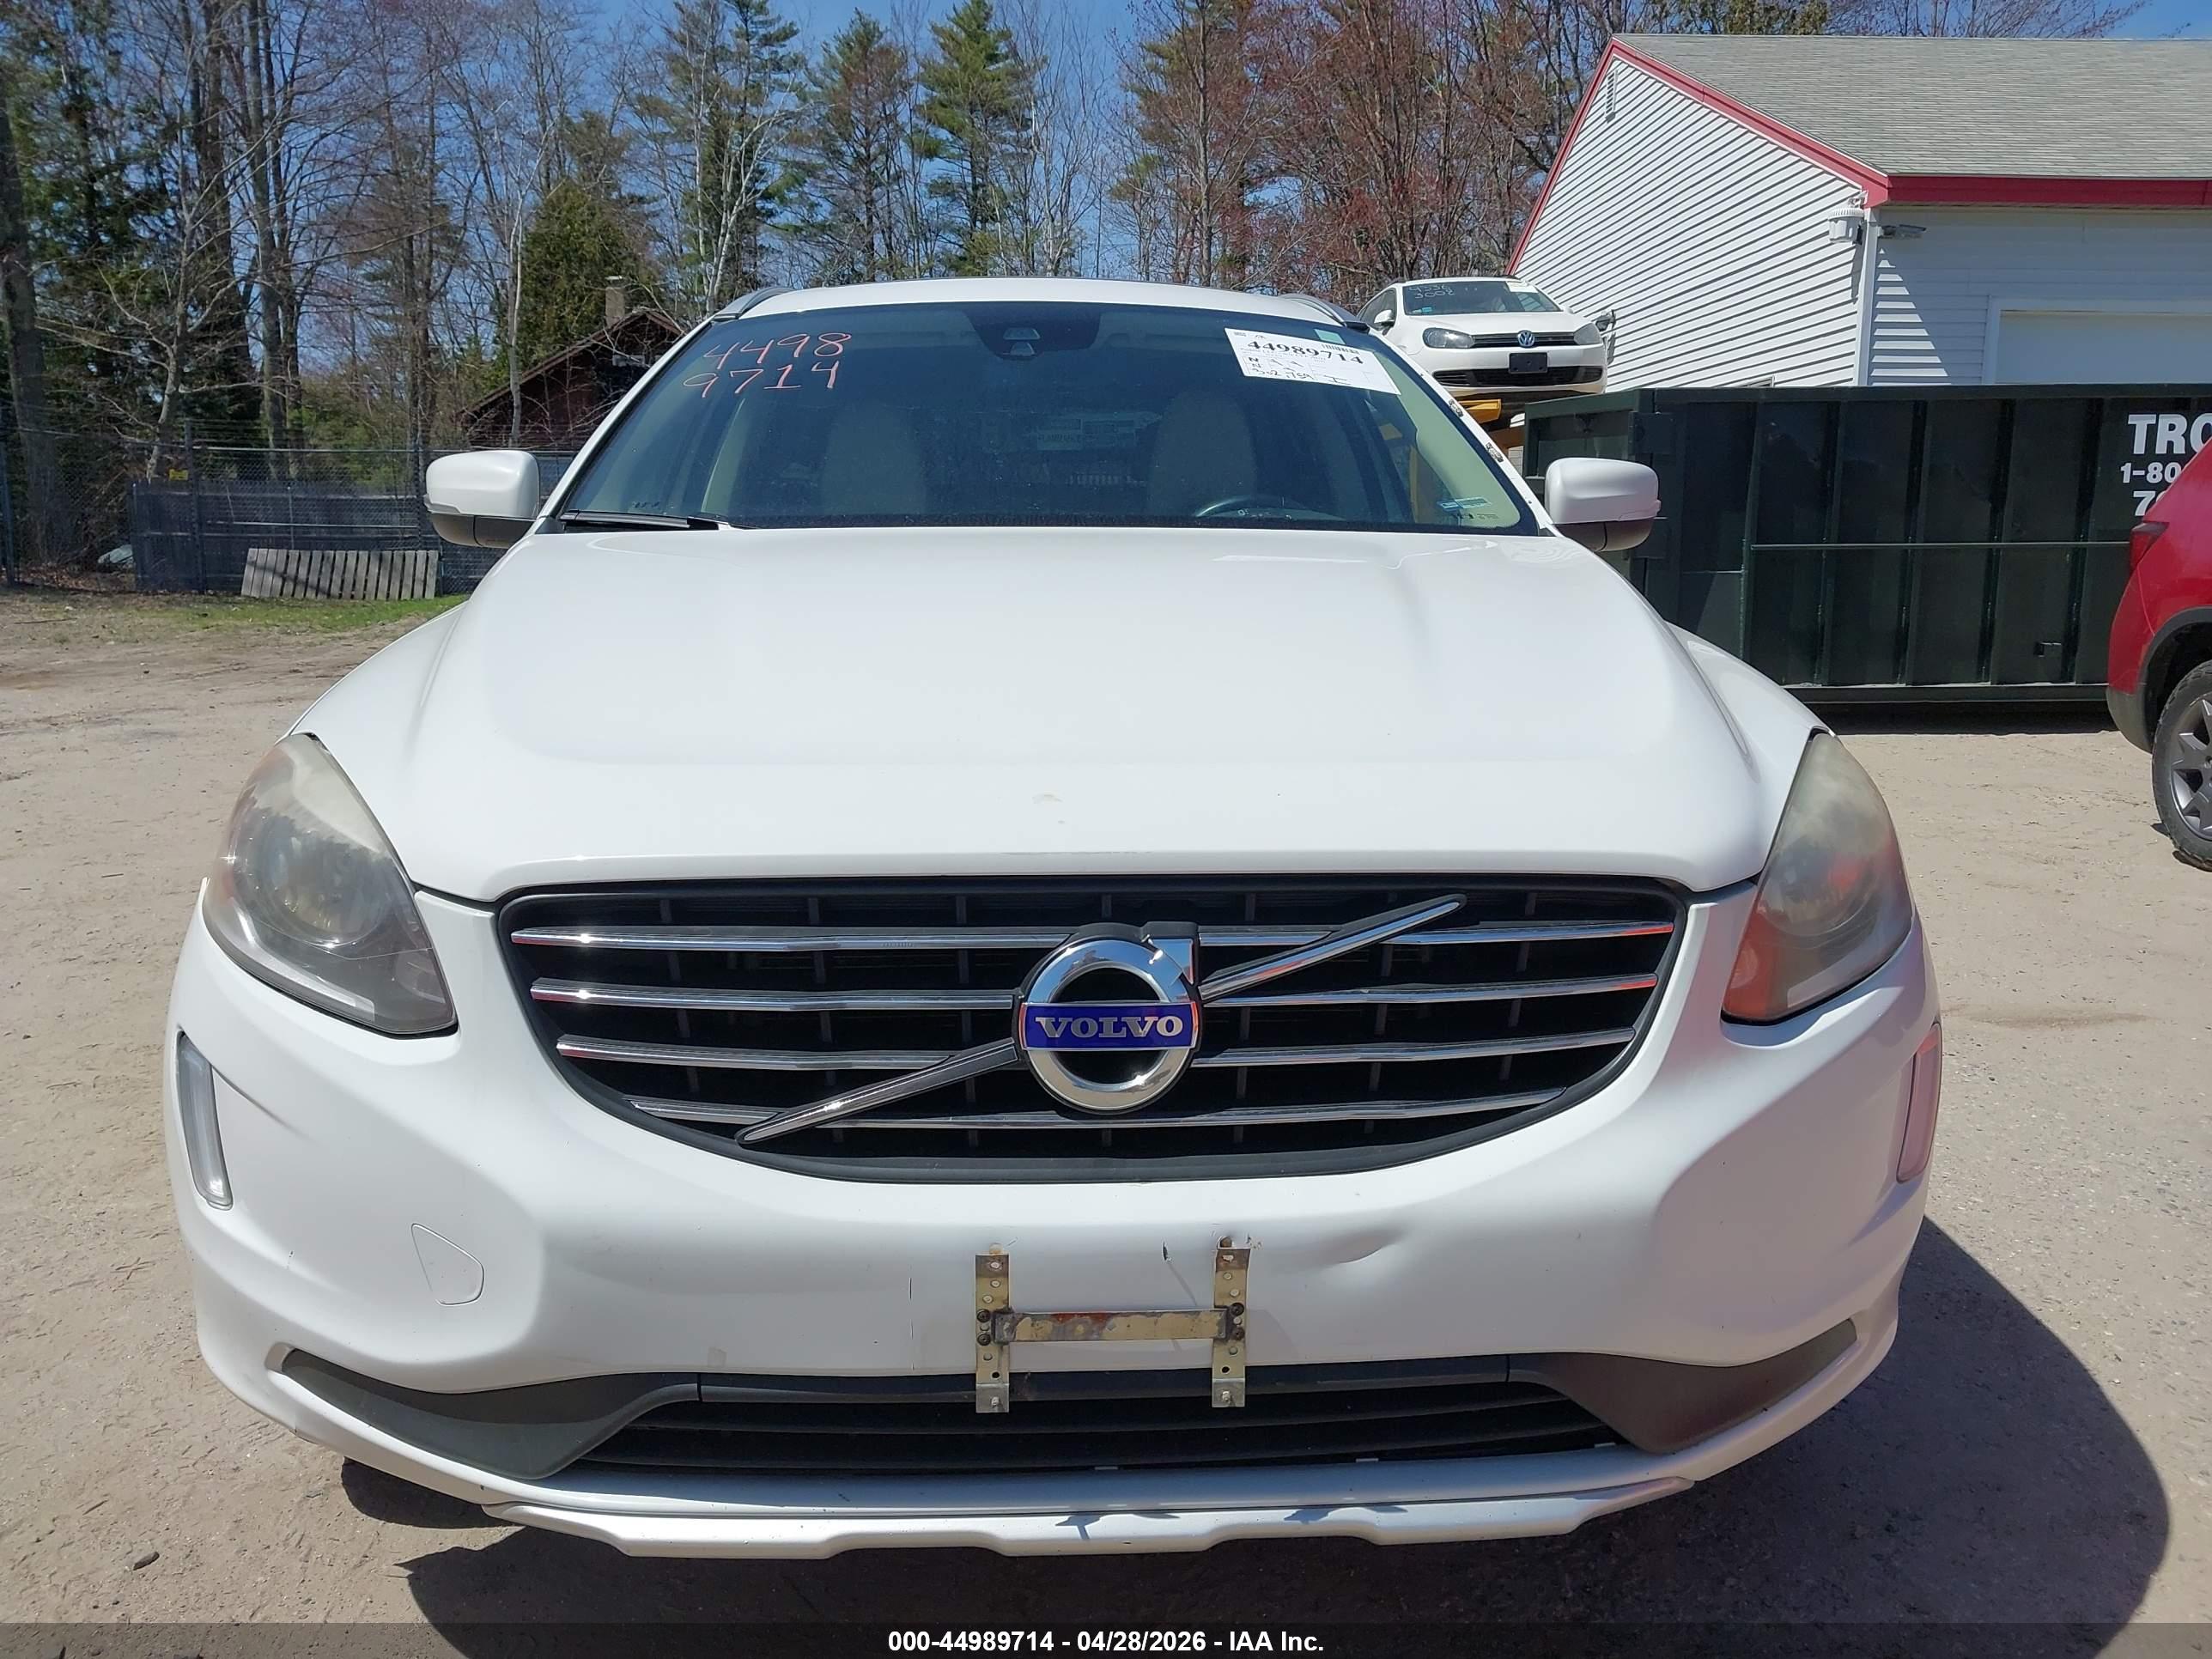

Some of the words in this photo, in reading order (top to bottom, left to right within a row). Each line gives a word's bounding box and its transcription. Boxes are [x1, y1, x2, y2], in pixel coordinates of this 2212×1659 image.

[703, 332, 852, 370] 4498
[1248, 341, 1364, 364] 44989714
[683, 361, 840, 398] 9714
[1036, 1016, 1183, 1038] VOLVO
